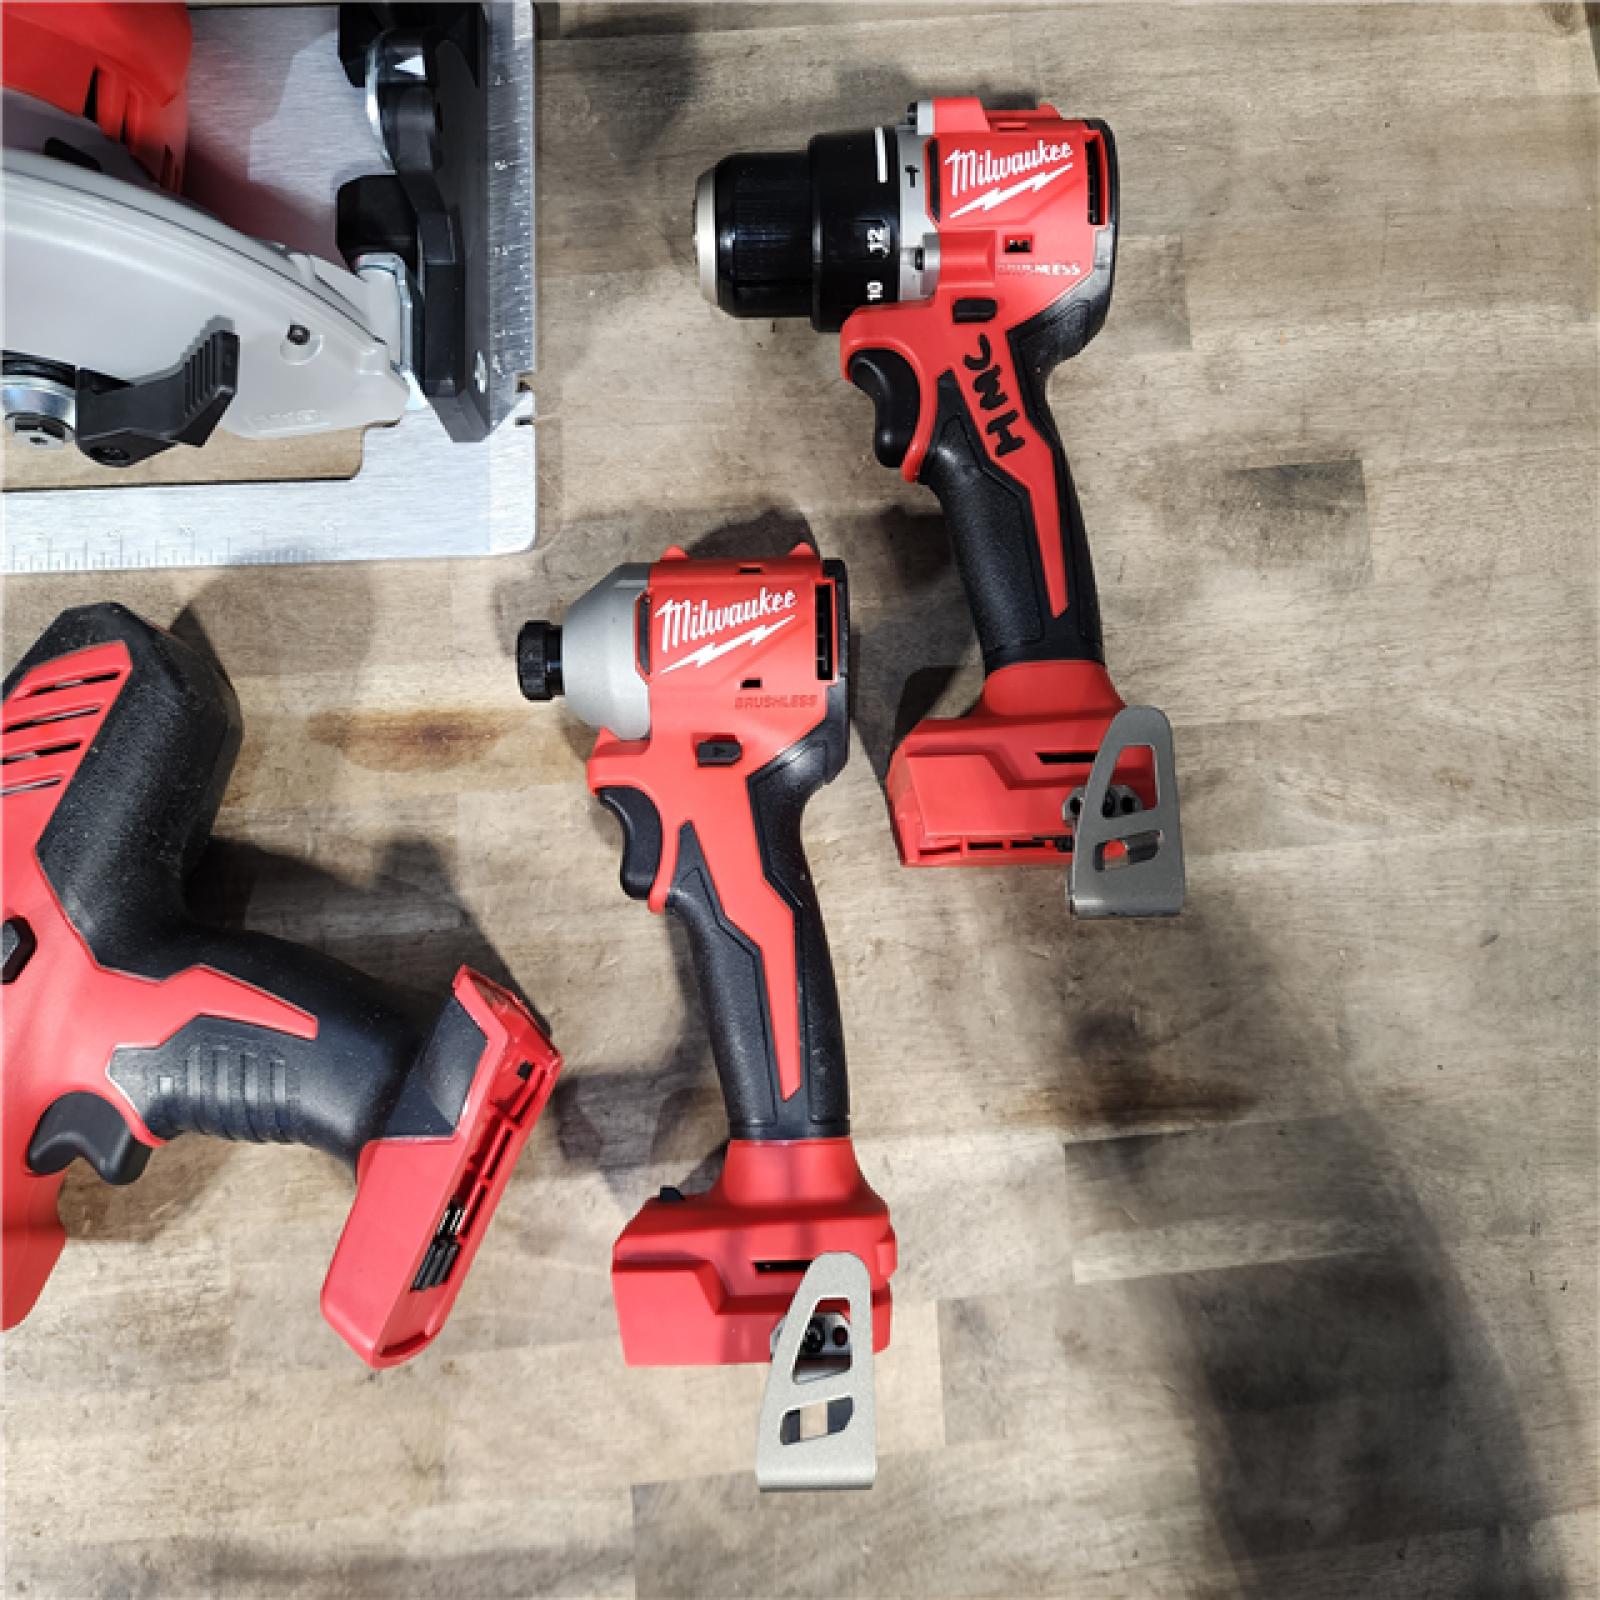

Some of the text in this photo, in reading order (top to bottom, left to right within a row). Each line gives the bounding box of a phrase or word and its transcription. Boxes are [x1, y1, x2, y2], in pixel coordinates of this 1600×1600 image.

[944, 139, 1073, 198] Milwaukee
[866, 227, 883, 253] 12
[866, 281, 883, 301] 10
[654, 586, 797, 653] Milwaukee
[734, 694, 818, 711] BRUSHLESS
